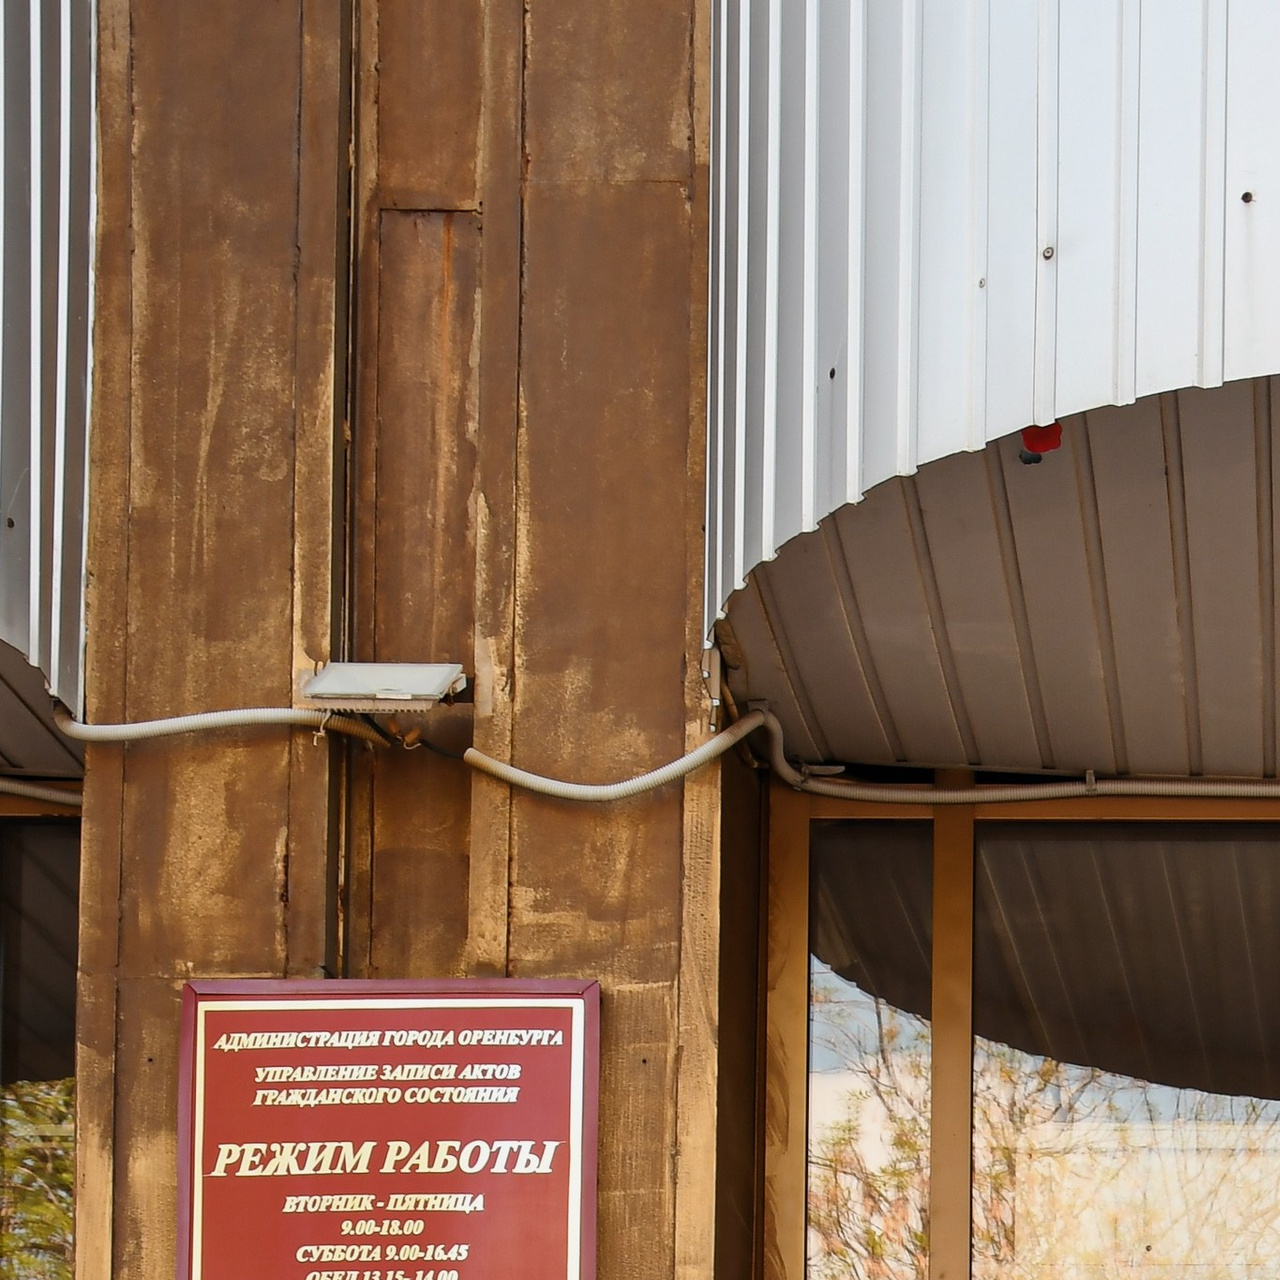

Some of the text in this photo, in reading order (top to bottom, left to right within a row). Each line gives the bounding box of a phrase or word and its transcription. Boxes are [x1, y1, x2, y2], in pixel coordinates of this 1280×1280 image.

[212, 1029, 564, 1052] АДМИНИСТРАЦИЯ ГОРОДА ОРЕНБУРГА
[254, 1063, 522, 1083] УПРАВЛЕНИЕ ЗАПИСИ АКТОВ
[252, 1086, 521, 1108] ГРАЖДАНСКОГО СОСТОЯНИЯ
[209, 1139, 561, 1177] РЕЖИМ РАБОТЫ
[282, 1194, 376, 1213] ВТОРНИК
[385, 1193, 485, 1215] ПЯТНИЦА
[340, 1219, 425, 1236] 9.00-18.00
[296, 1244, 470, 1263] СУББОТА 9.00-16.45
